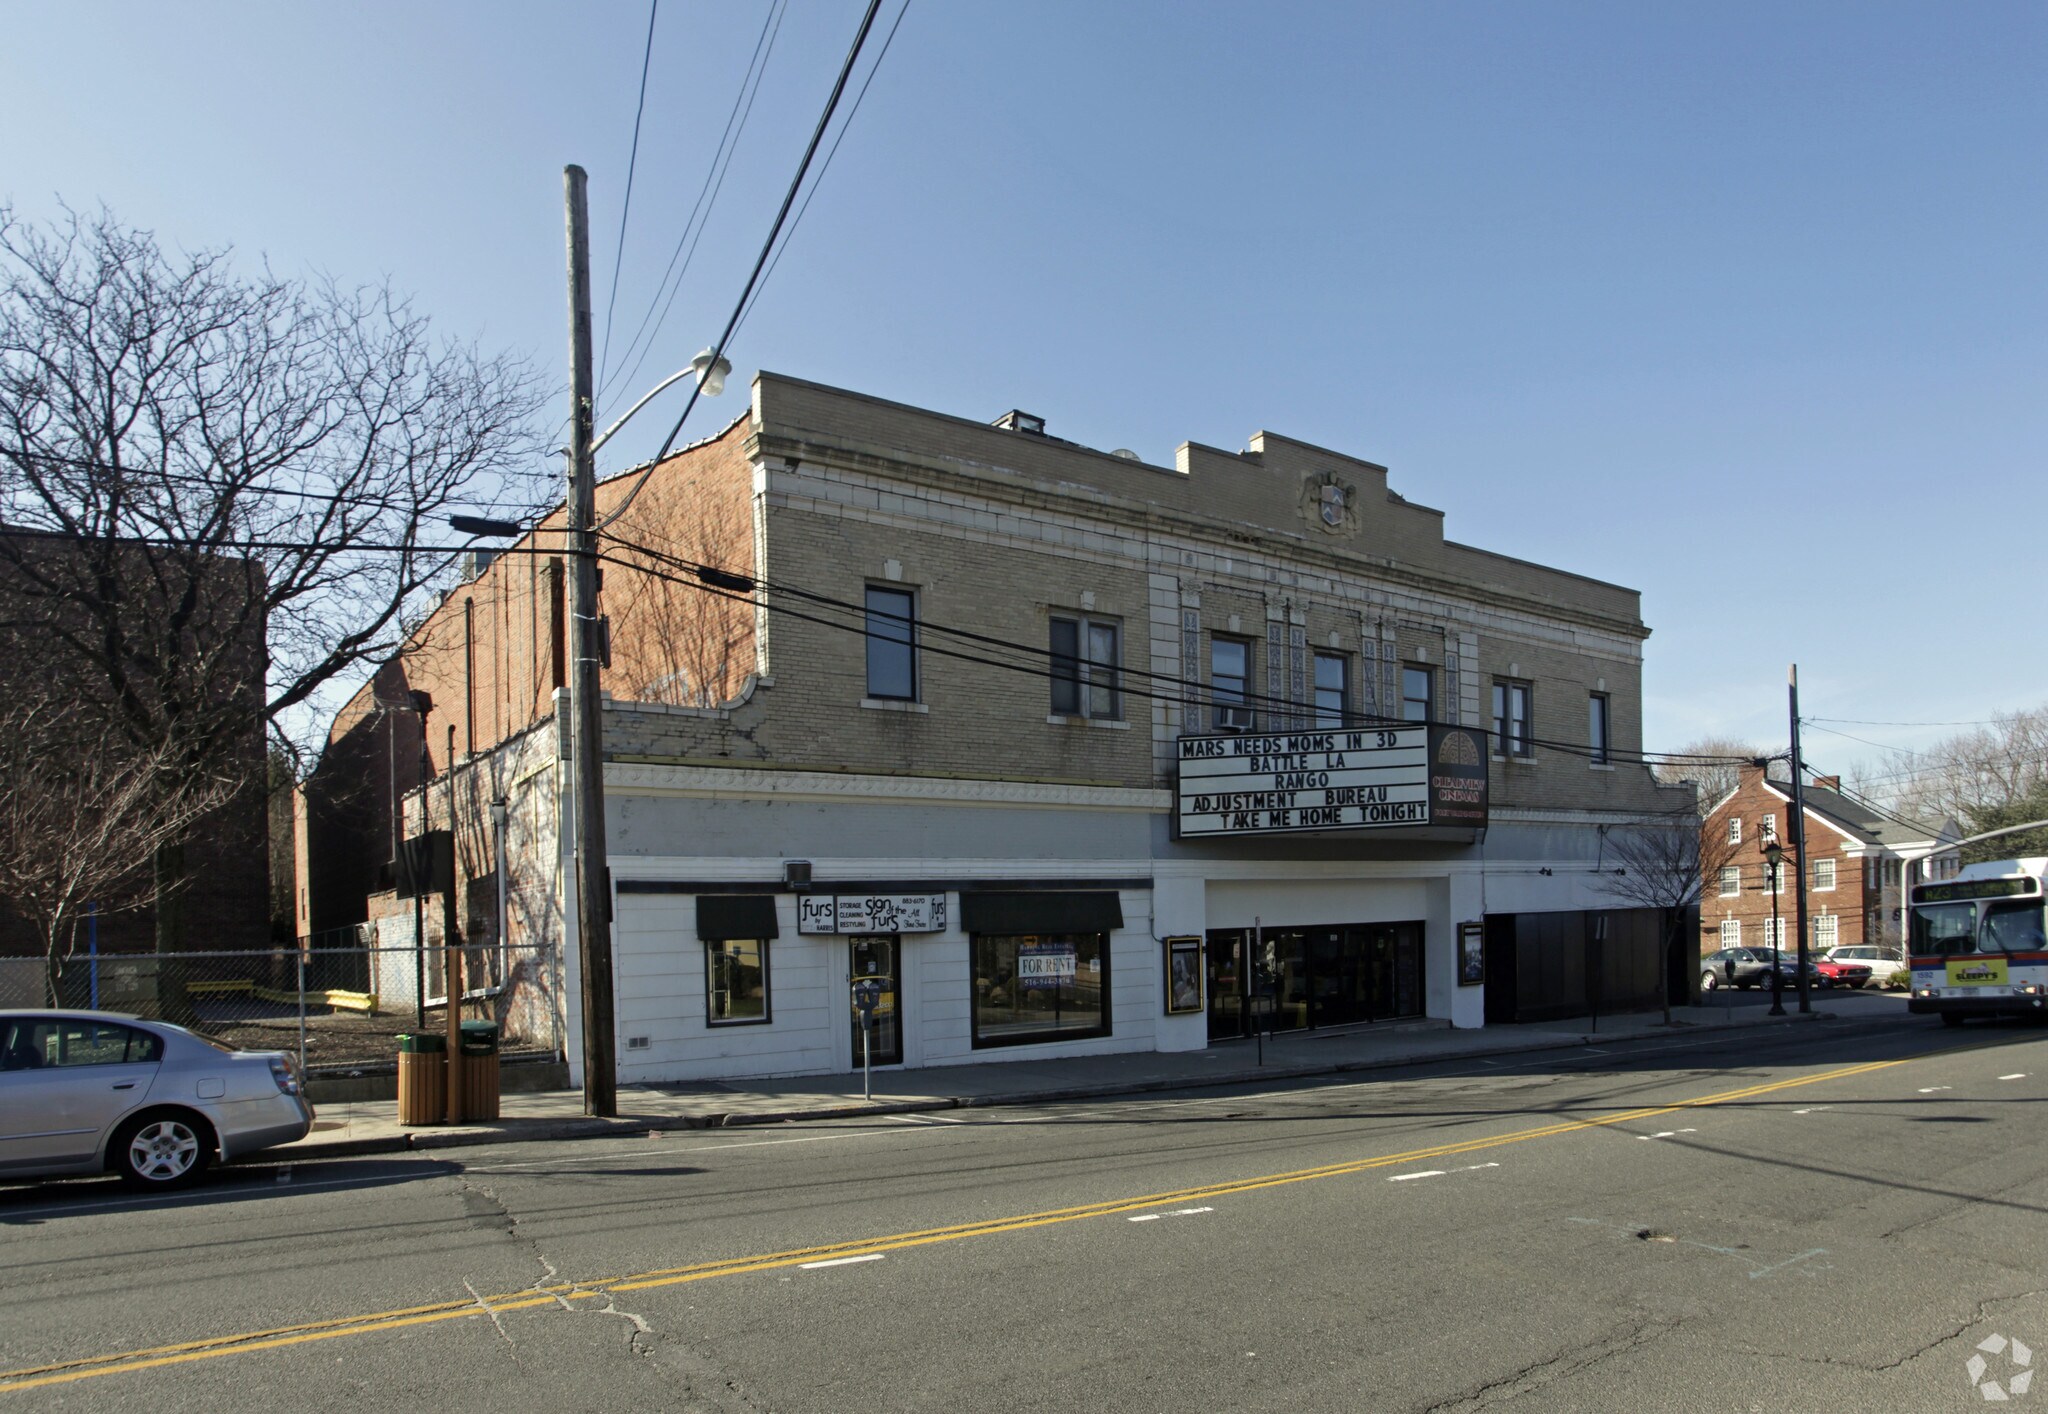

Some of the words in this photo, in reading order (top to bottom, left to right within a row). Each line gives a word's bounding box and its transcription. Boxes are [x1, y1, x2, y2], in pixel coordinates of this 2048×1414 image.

[1183, 740, 1225, 757] MARS
[1233, 737, 1282, 755] NEEDS
[1288, 735, 1334, 752] MOMS
[1346, 733, 1362, 749] IN
[1377, 732, 1397, 748] 3D
[1250, 754, 1308, 772] BATTLE
[1326, 753, 1345, 768] LA
[1275, 772, 1329, 789] RANGO
[1192, 792, 1297, 812] ADJUSTMENT
[1325, 787, 1387, 805] BUREAU
[1220, 812, 1259, 829] TAKE
[1269, 810, 1291, 827] ME
[1300, 807, 1342, 825] HOME
[1359, 803, 1427, 821] TONIGHT
[802, 898, 833, 921] furs
[865, 896, 891, 916] Sign
[885, 905, 895, 916] of
[895, 905, 907, 915] the
[871, 912, 899, 932] furs
[1022, 958, 1043, 974] FOR
[1046, 957, 1071, 973] RENT
[1955, 972, 1998, 980] SLEEPY'S
